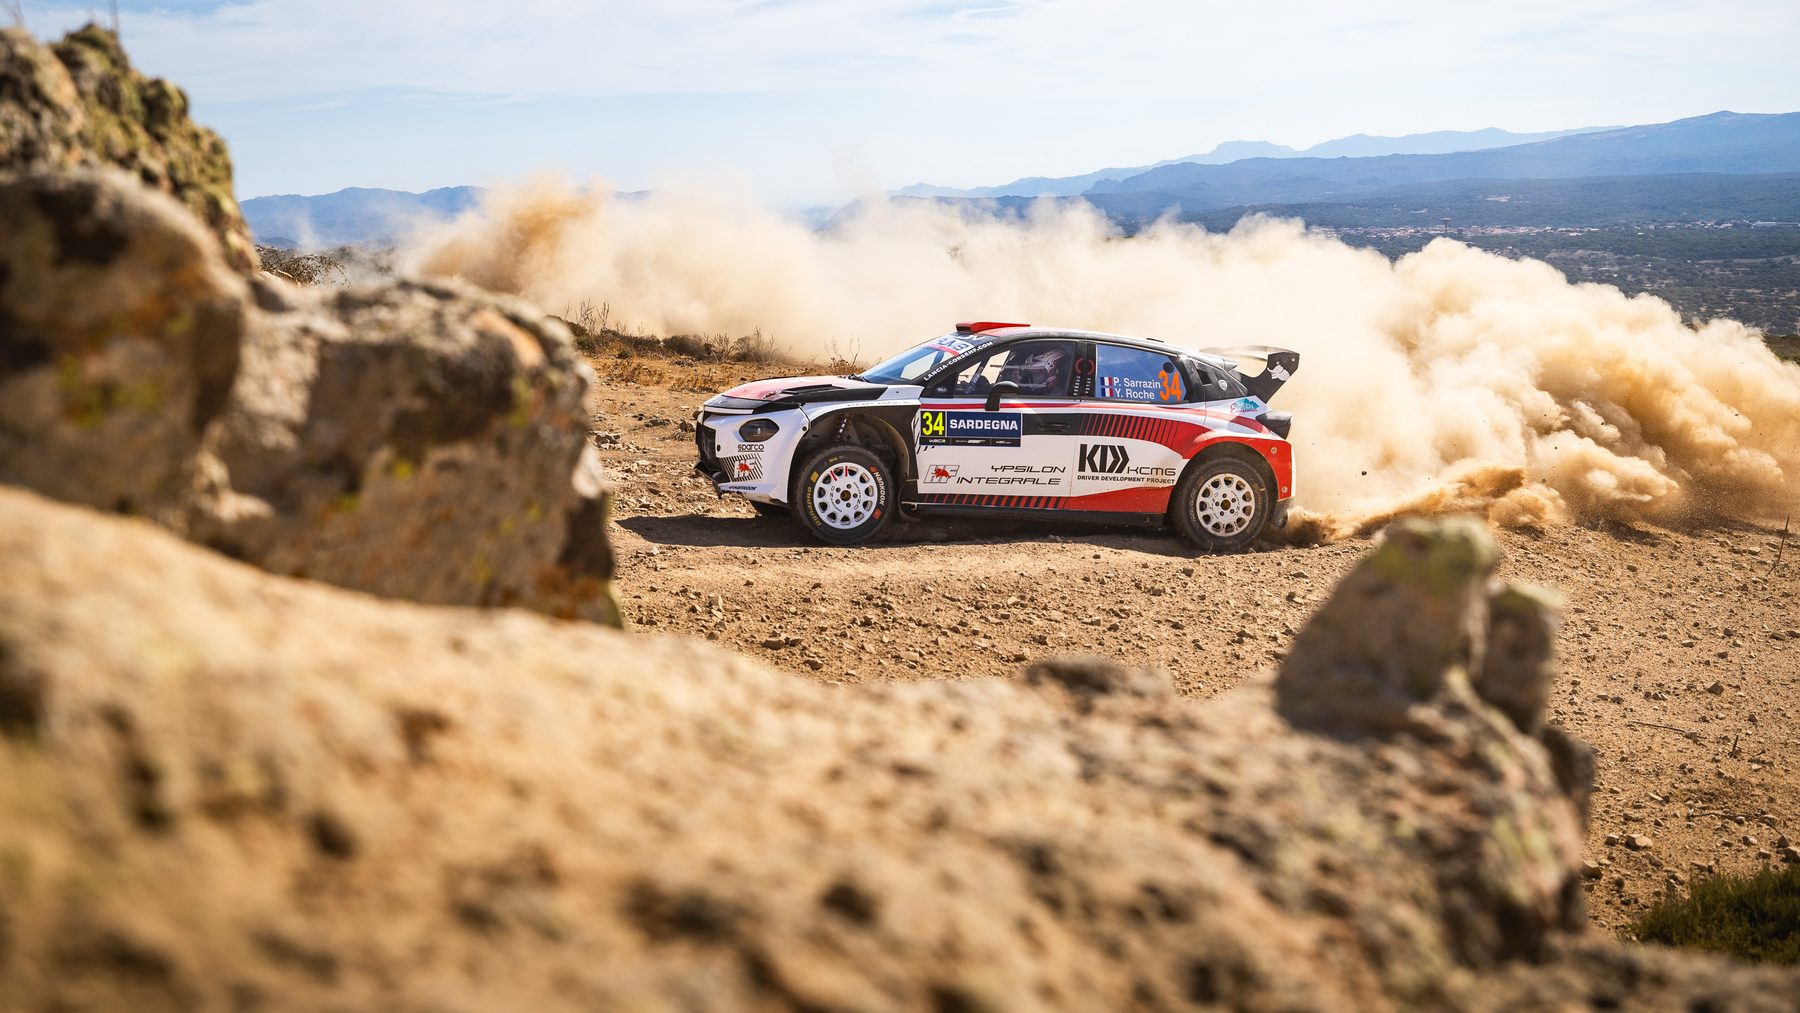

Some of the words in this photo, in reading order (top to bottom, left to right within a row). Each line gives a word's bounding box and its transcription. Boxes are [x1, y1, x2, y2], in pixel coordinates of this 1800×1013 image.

[1113, 377, 1121, 387] P.
[1123, 377, 1161, 389] Sarrazin
[1159, 369, 1182, 401] 34
[1115, 388, 1123, 398] Y.
[1126, 389, 1155, 400] Roche
[922, 412, 944, 435] 34
[949, 419, 1018, 430] SARDEGNA
[737, 443, 764, 451] sparco
[991, 465, 1066, 473] YPSILON
[956, 476, 1062, 485] INTEGRALE
[1101, 475, 1145, 483] DEVELOPMENT
